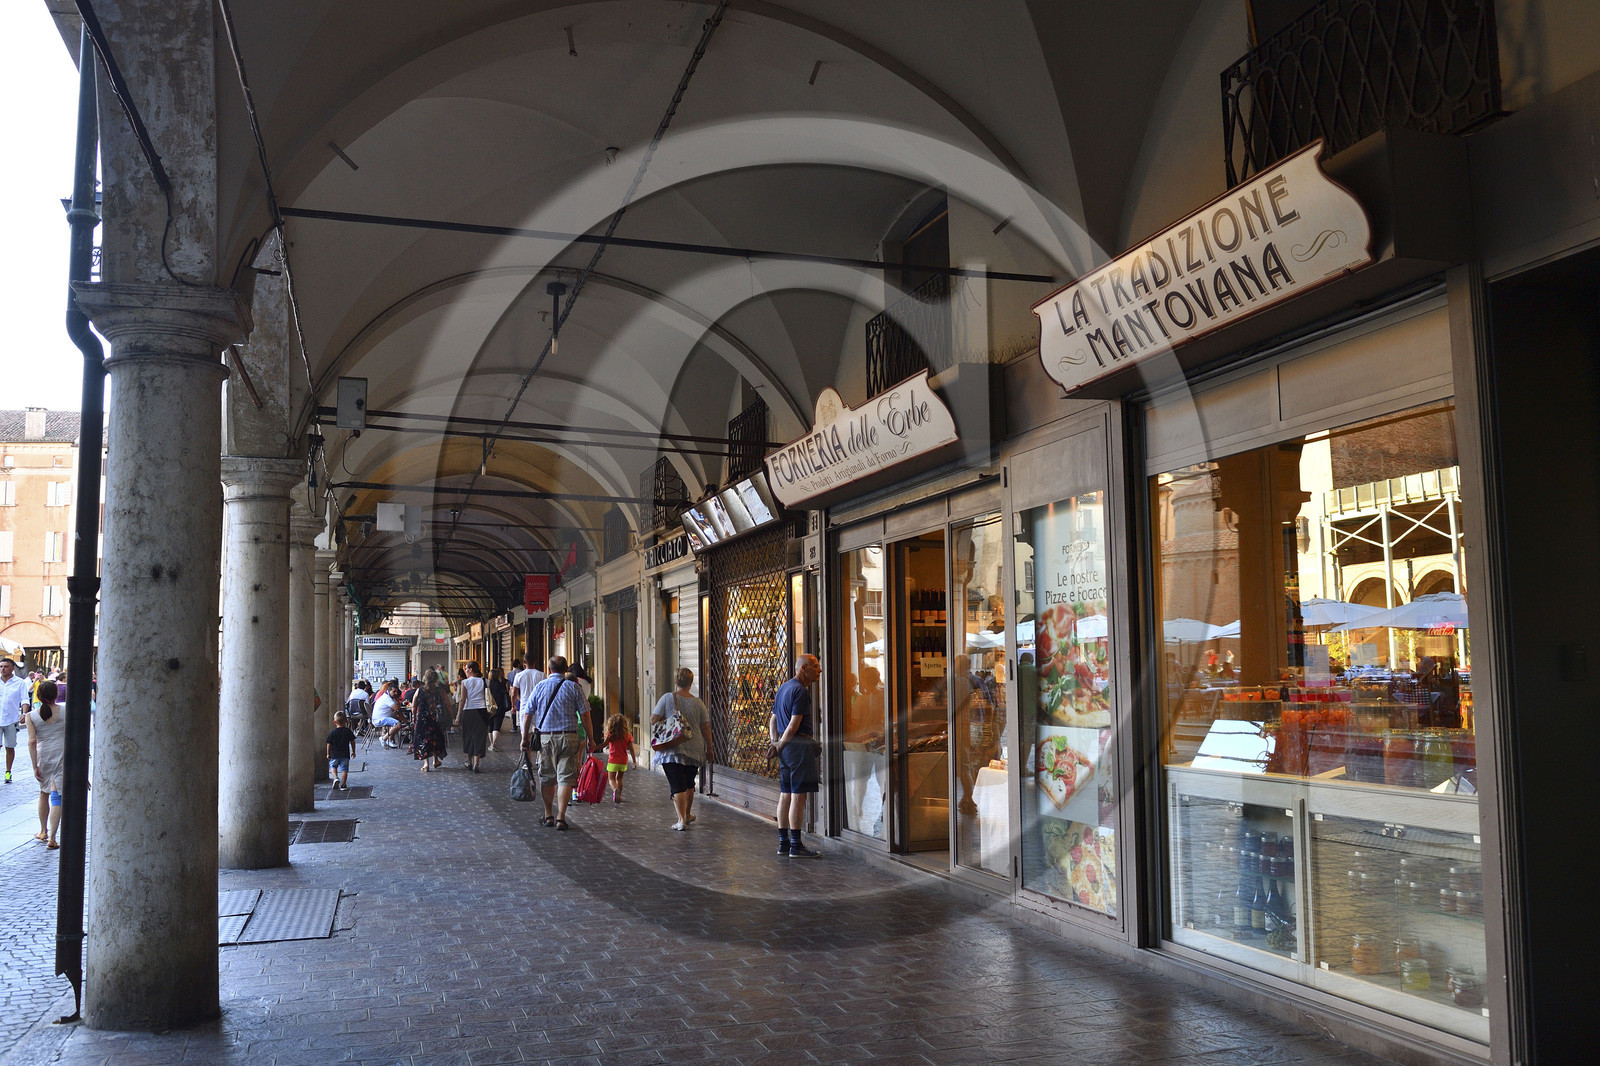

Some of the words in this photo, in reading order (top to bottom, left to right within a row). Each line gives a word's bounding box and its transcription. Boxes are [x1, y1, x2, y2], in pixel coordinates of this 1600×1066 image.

[1054, 290, 1091, 337] LA
[1090, 173, 1301, 315] TRADIZIONE
[1085, 242, 1296, 368] MANTOVANA
[770, 424, 850, 489] FORNERIA
[847, 413, 878, 456] delle
[877, 390, 932, 439] Erbe
[834, 460, 867, 482] Artigianali
[865, 456, 876, 468] da
[875, 450, 897, 466] Forno
[1045, 590, 1067, 605] Pizze
[1069, 591, 1075, 602] e
[1057, 572, 1068, 587] Le
[1070, 570, 1099, 585] nostre
